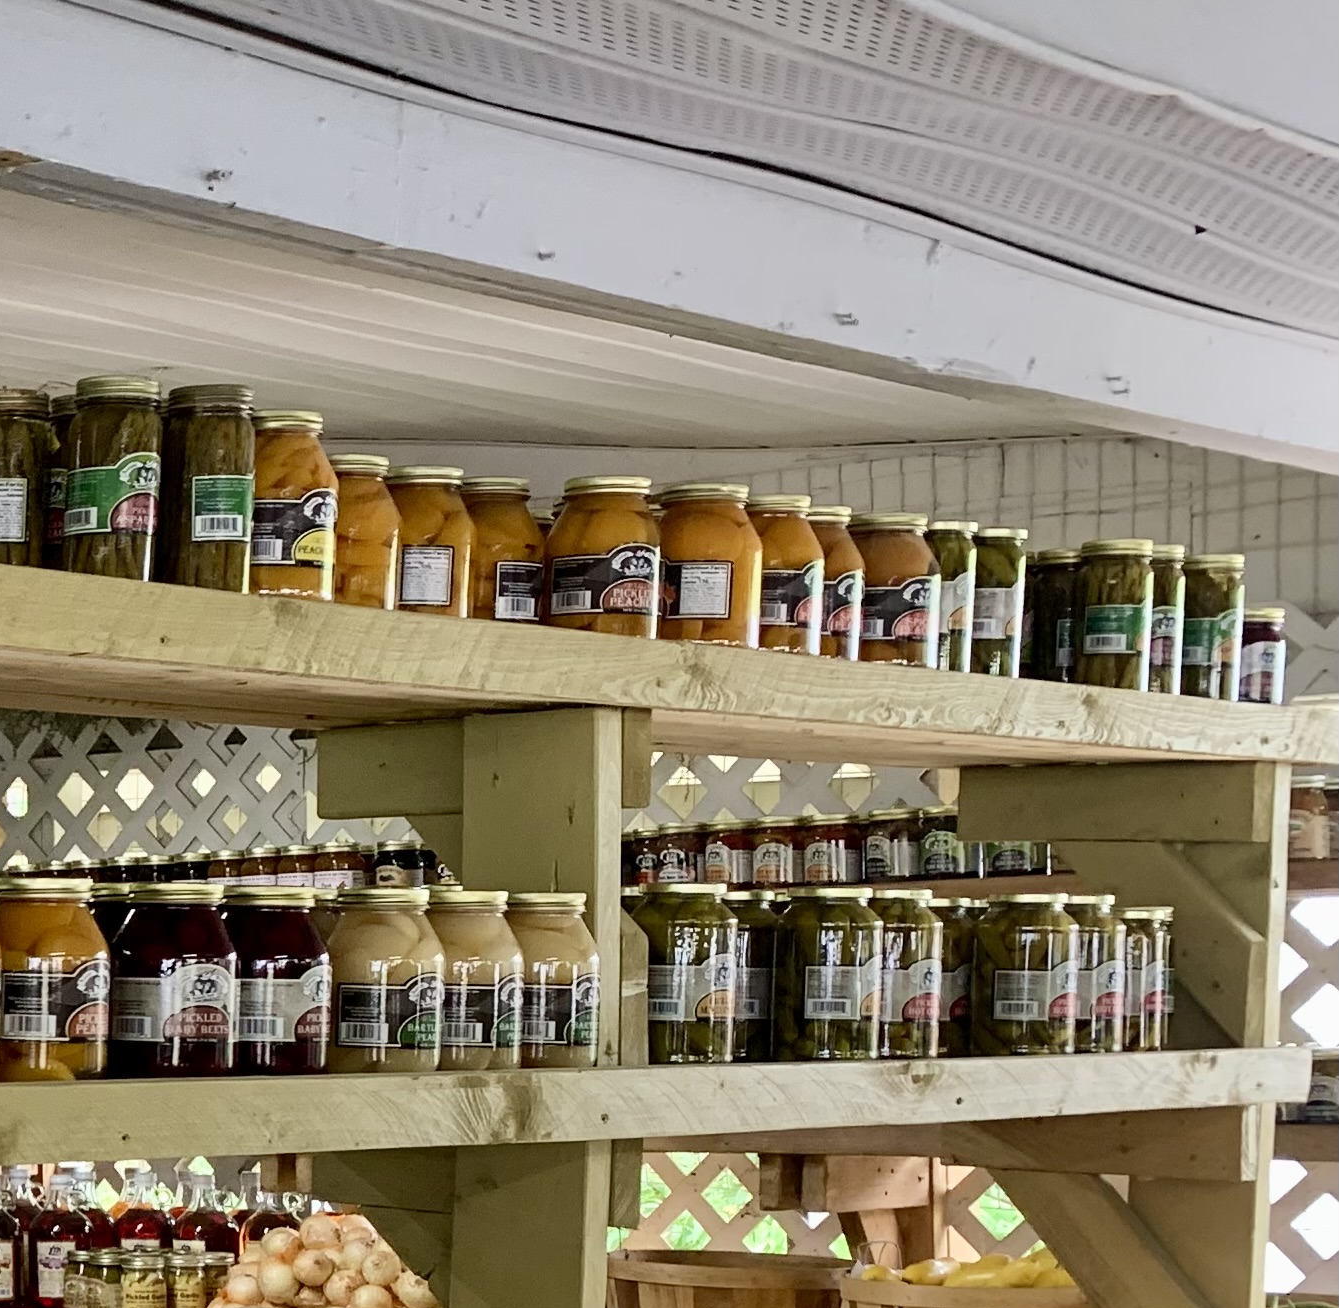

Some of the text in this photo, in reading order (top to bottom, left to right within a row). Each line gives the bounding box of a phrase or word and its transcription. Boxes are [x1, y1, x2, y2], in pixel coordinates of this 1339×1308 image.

[178, 1013, 222, 1023] PICKLED
[165, 1024, 230, 1035] BABY BEETS
